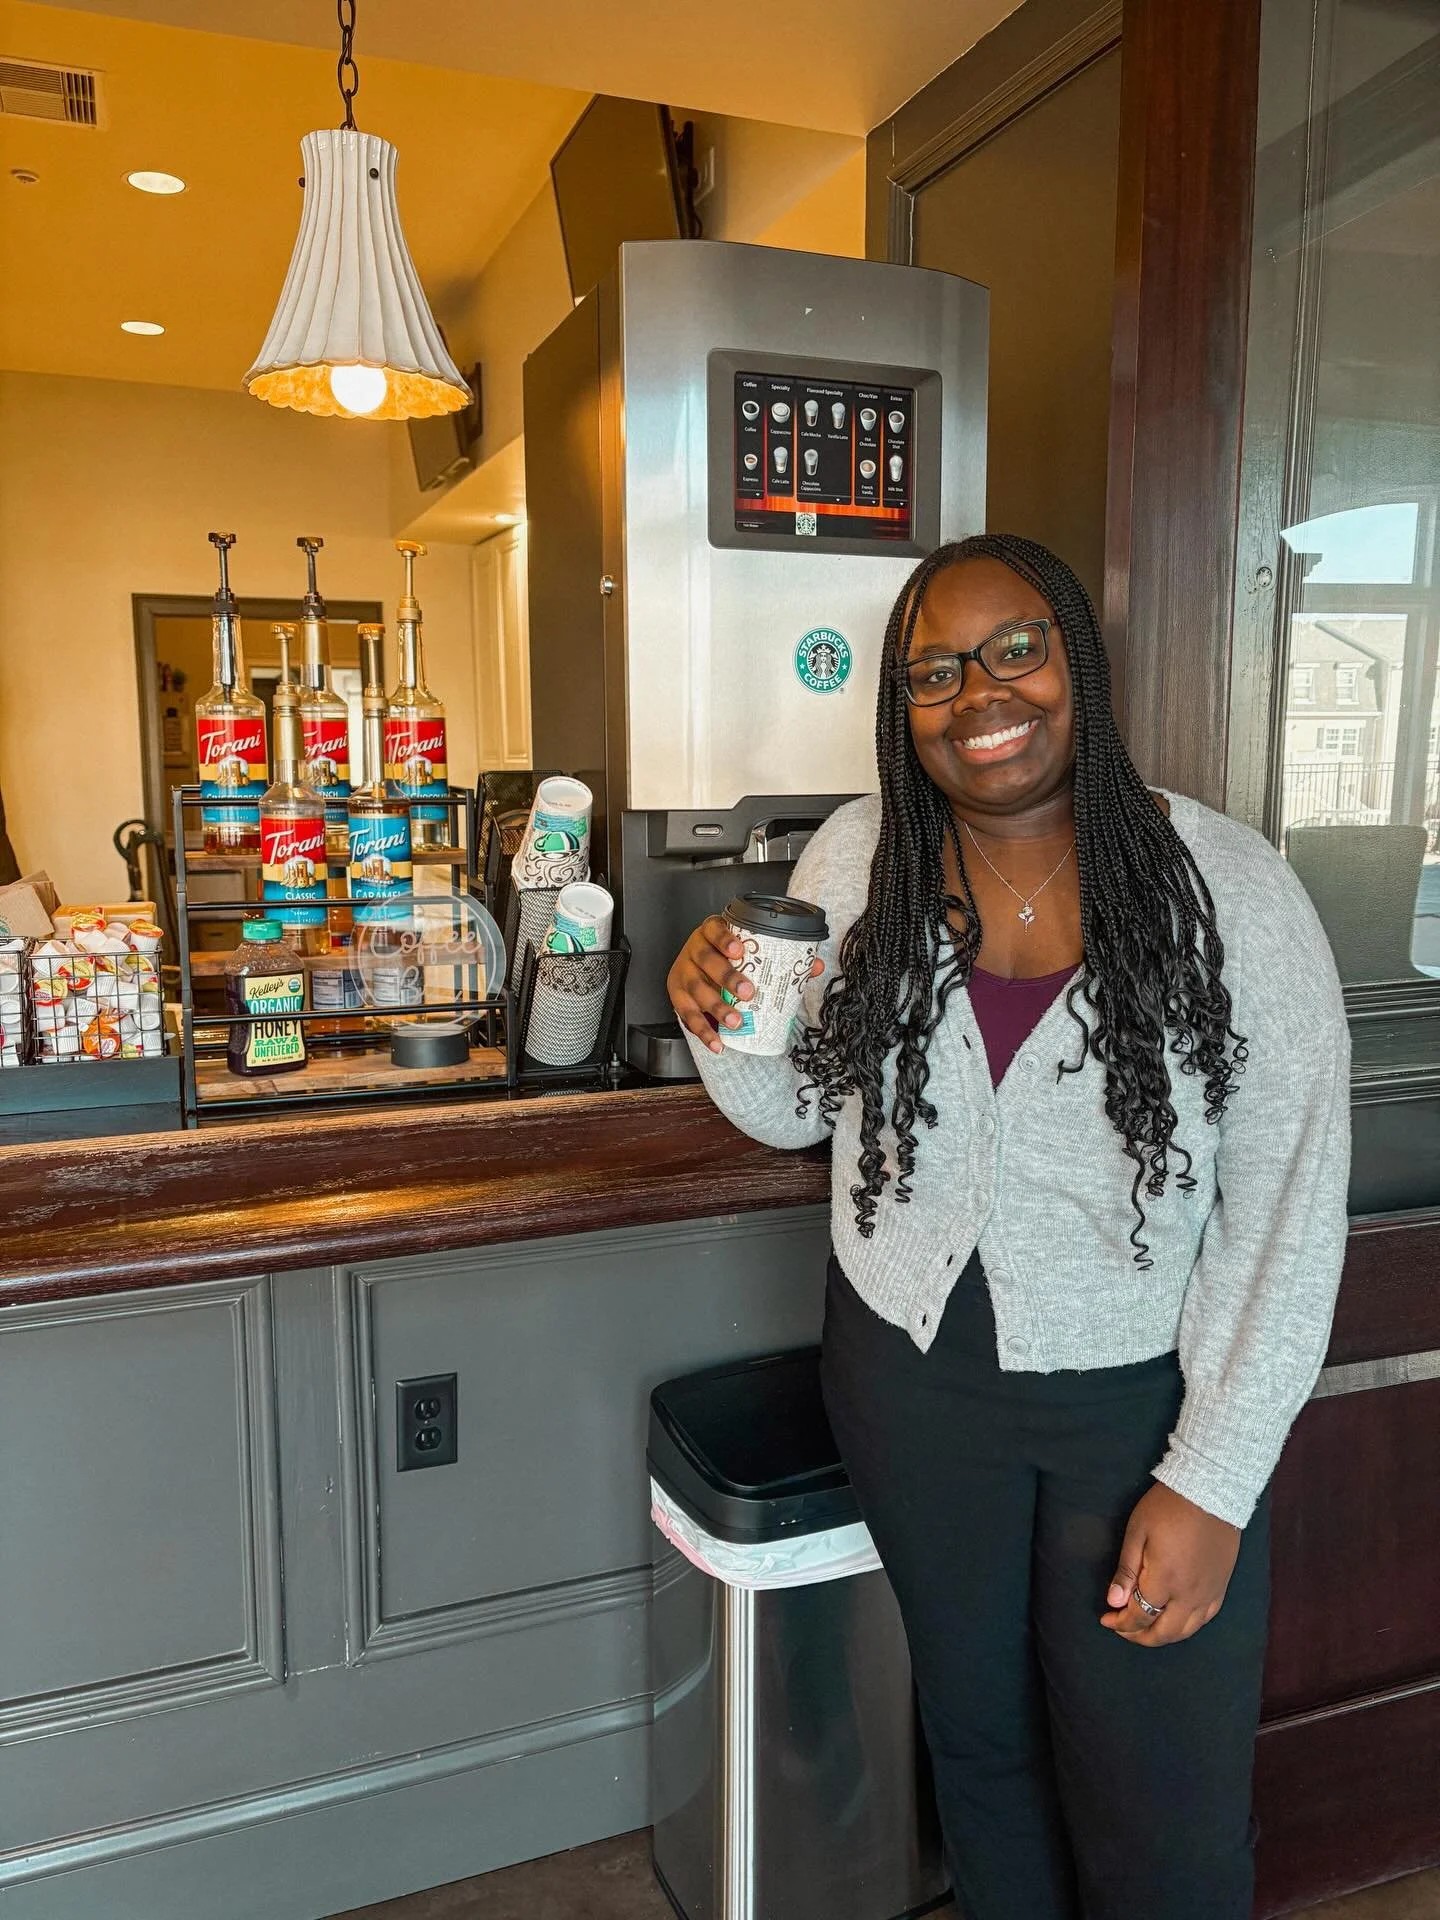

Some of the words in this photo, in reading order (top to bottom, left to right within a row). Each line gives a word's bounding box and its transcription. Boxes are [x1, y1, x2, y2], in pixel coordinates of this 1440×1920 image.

[771, 384, 790, 392] Specialty
[799, 632, 849, 658] STARBUCKS
[804, 673, 842, 690] COFFEE
[200, 729, 262, 767] Torani
[385, 731, 444, 765] Torani
[264, 827, 325, 867] Torani
[349, 826, 406, 864] Torani
[285, 891, 316, 900] CLASSIC
[249, 978, 284, 1000] Kelley's
[250, 996, 300, 1015] ORGANIC
[254, 1020, 299, 1039] HONEY
[254, 1043, 300, 1058] UNFILTERED
